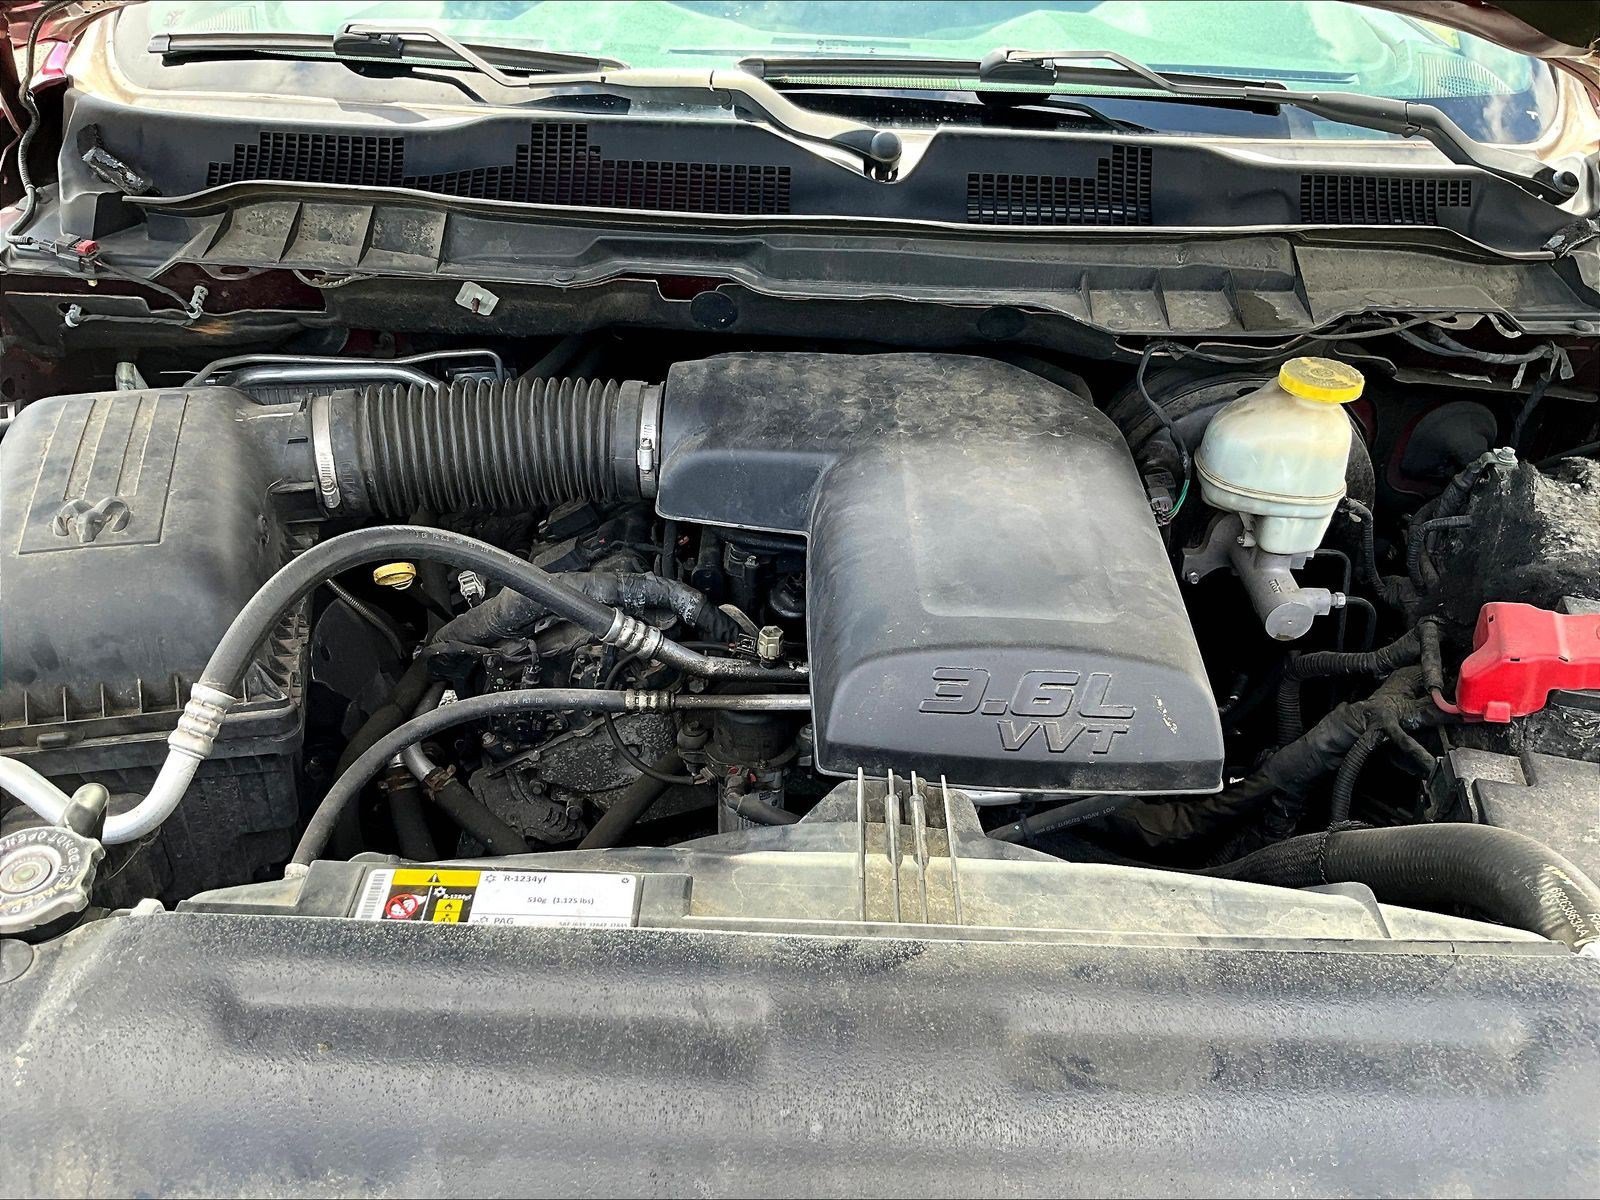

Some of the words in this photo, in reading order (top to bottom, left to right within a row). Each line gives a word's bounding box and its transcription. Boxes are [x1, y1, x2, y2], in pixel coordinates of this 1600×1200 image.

[918, 666, 1136, 719] 3.6L
[997, 720, 1130, 754] VVT
[504, 875, 548, 884] R-1234yf
[493, 917, 514, 925] PAG
